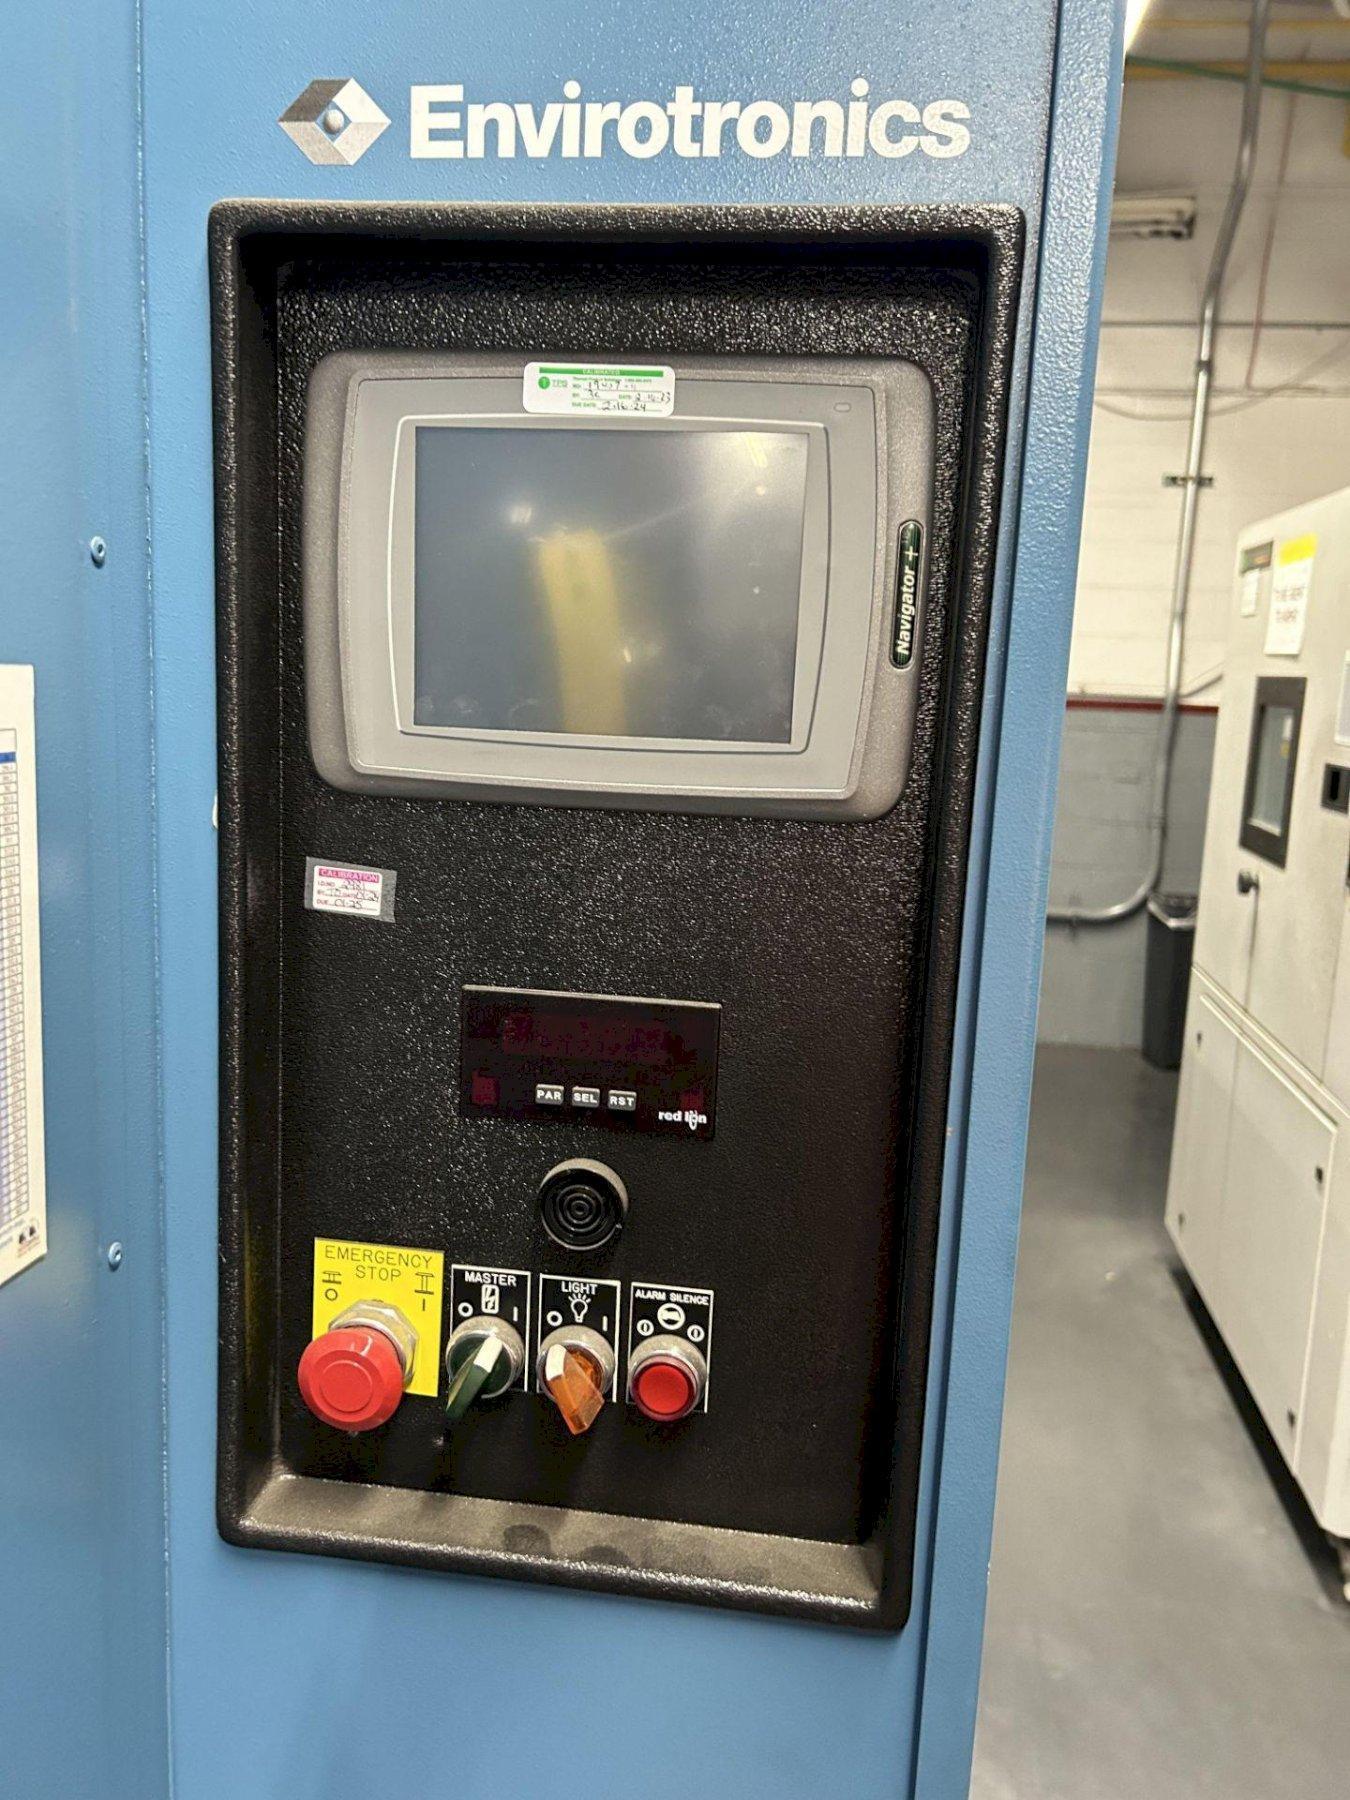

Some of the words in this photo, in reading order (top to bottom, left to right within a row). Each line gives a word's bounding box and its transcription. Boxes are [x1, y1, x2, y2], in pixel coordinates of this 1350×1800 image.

[410, 78, 972, 160] Envirotronics
[895, 565, 916, 655] Navigator
[536, 1089, 562, 1100] PAR
[573, 1092, 598, 1104] SEL
[609, 1096, 635, 1107] RST
[658, 1110, 682, 1123] red
[325, 1245, 433, 1269] EMERGENCY
[355, 1265, 401, 1282] STOP
[464, 1270, 517, 1287] MASTER
[561, 1281, 598, 1295] LIGHT
[635, 1288, 666, 1301] ALARM
[669, 1291, 710, 1306] SILENCE
